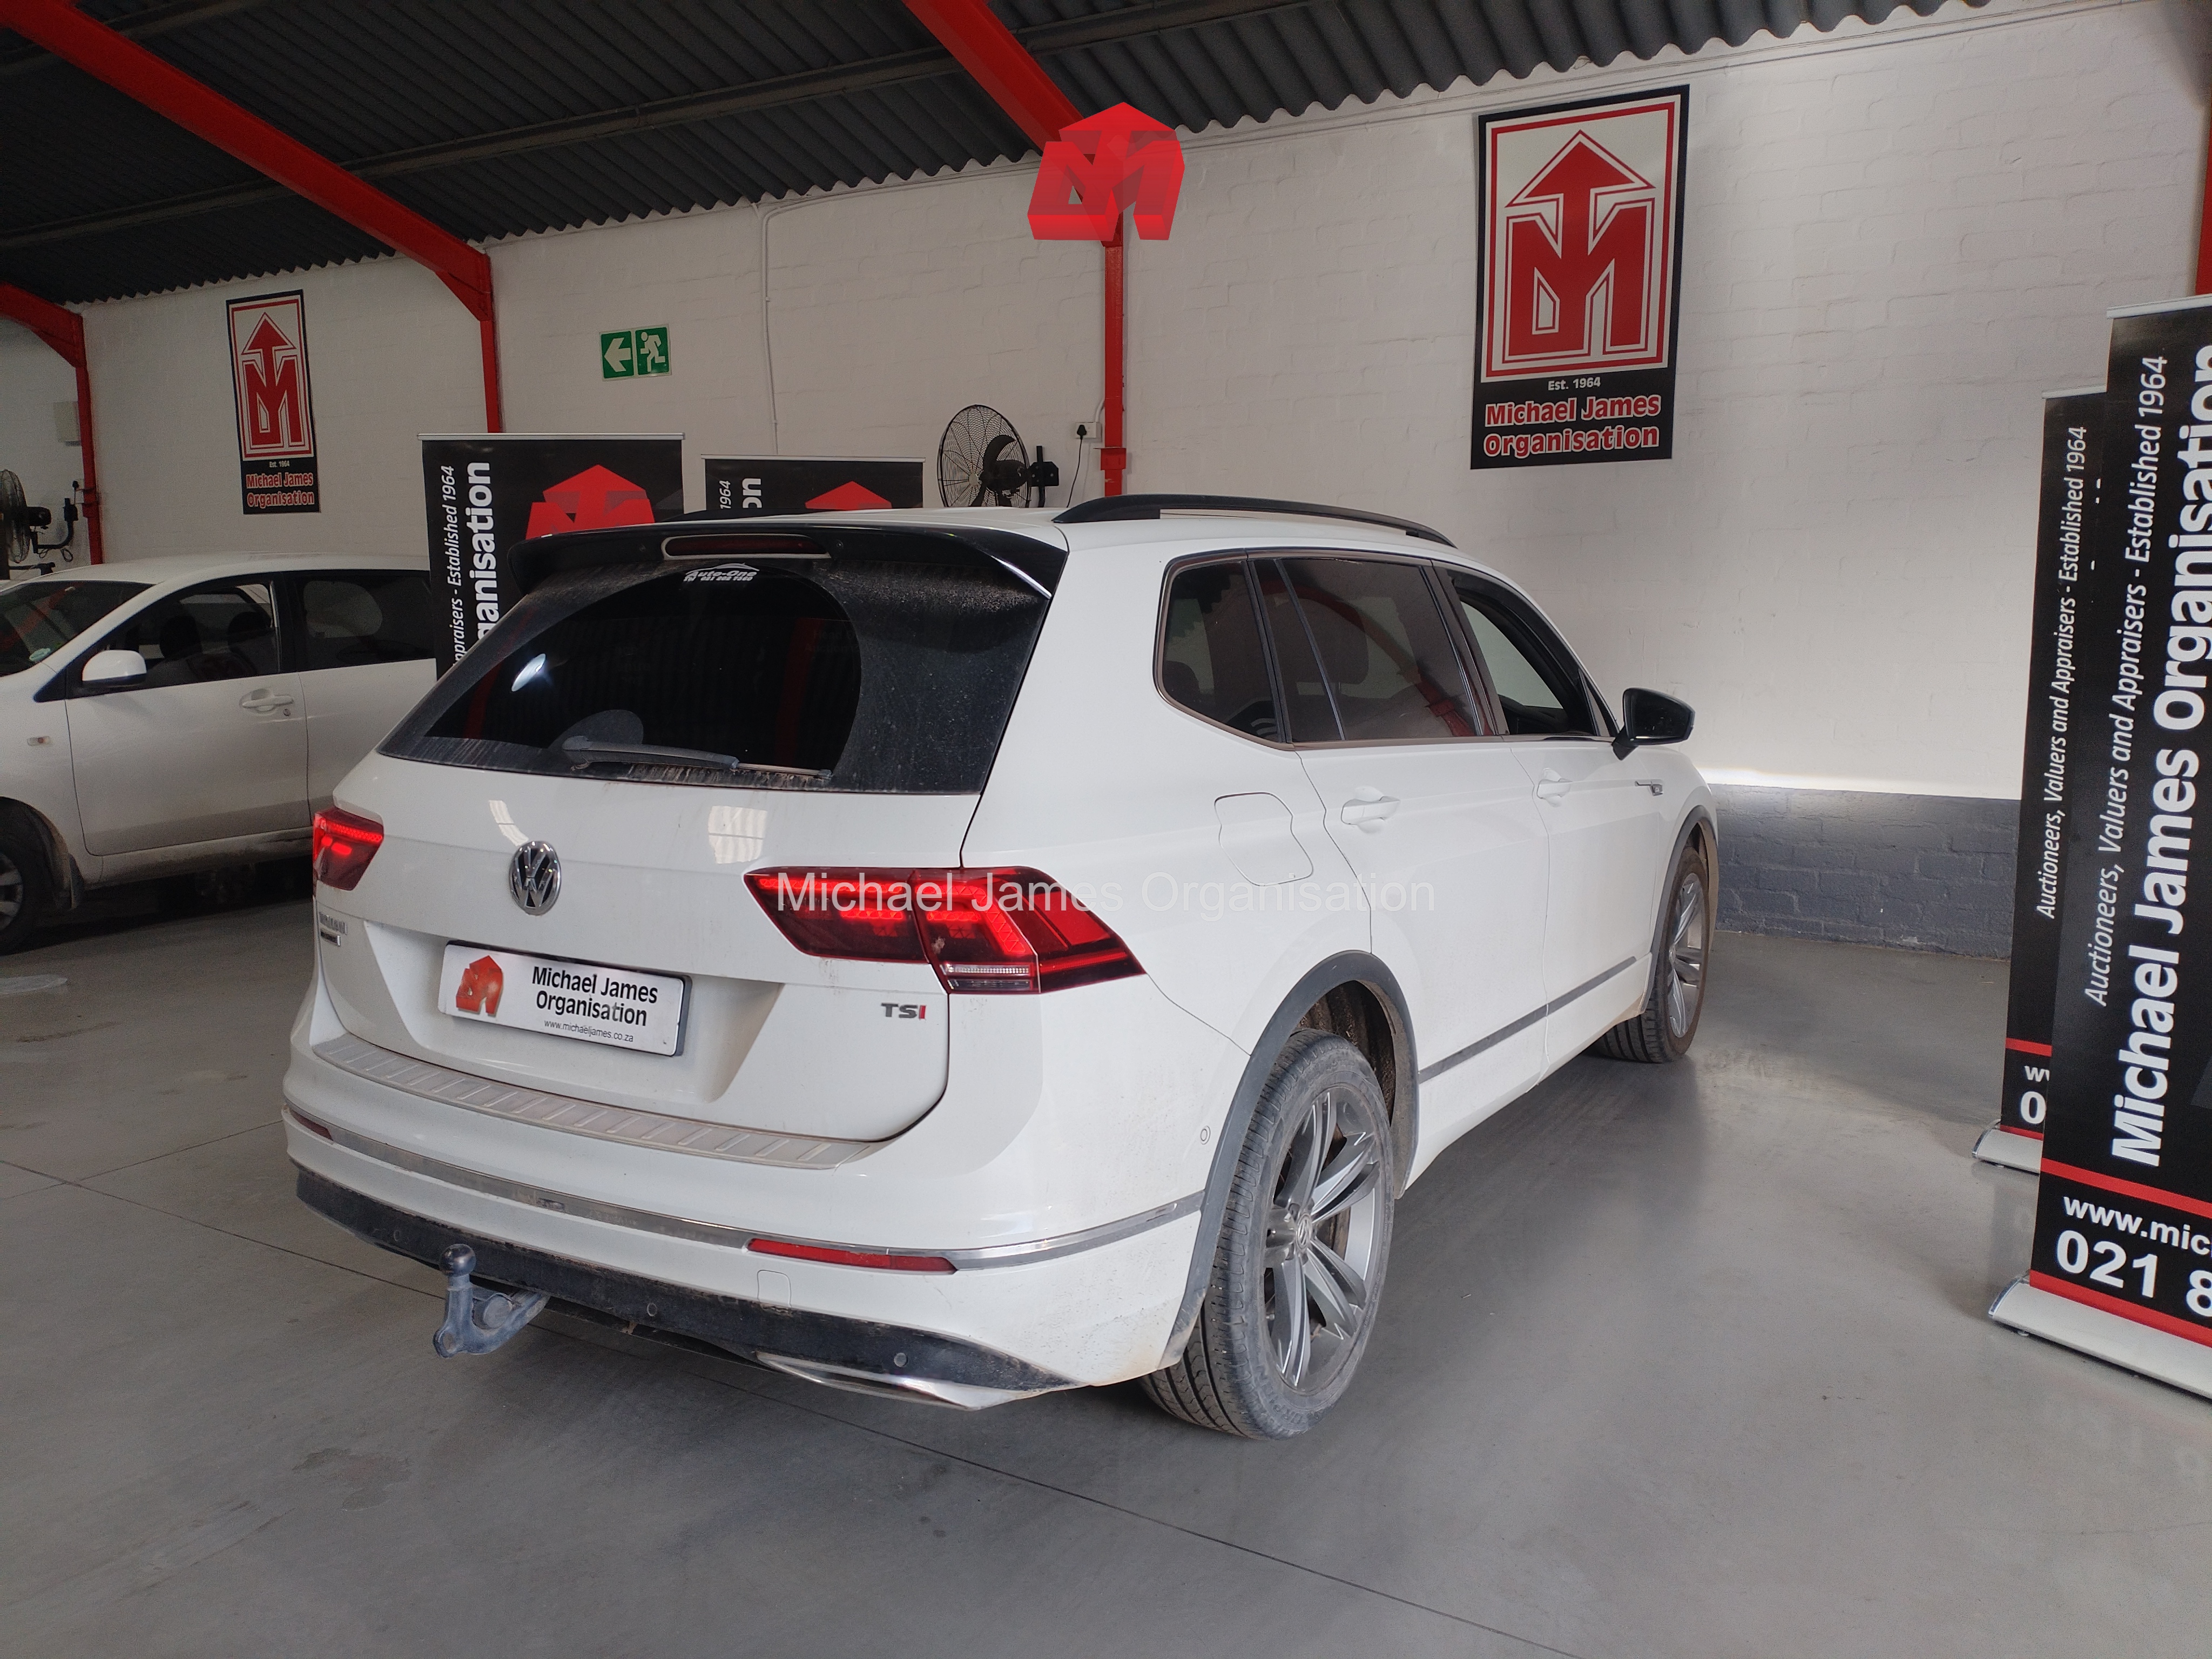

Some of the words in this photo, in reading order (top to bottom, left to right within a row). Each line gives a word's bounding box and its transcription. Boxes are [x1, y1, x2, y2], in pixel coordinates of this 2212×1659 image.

[1485, 397, 1576, 427] Michael
[1581, 394, 1661, 420] James
[1548, 379, 1569, 391] Est.
[1573, 376, 1601, 389] 1964
[2138, 356, 2168, 417] 1964
[1483, 424, 1660, 458] Organisation
[2065, 426, 2087, 473] 1964
[246, 473, 282, 489] Michael
[284, 471, 314, 487] James
[247, 490, 315, 509] Organisation
[440, 465, 455, 502] 1964
[2125, 424, 2162, 562] Established
[442, 504, 462, 587] Established
[2058, 476, 2084, 582] Established
[2052, 597, 2076, 694] Appraisers
[2112, 583, 2147, 711] Appraisers
[2049, 696, 2069, 732] and
[2109, 713, 2134, 761] and
[2044, 736, 2067, 801] Valuers
[2099, 767, 2129, 853] Valuers
[2036, 810, 2066, 919] Auctioneers,
[2134, 748, 2200, 935] James
[2084, 864, 2125, 1007] Auctioneers,
[532, 966, 598, 994] Michael
[601, 977, 658, 1004] James
[536, 990, 648, 1027] Organisation
[880, 1002, 926, 1019] TSI
[544, 1020, 633, 1043] www.michaeljames.co.za
[2111, 945, 2180, 1167] Michael
[2063, 1196, 2212, 1258] www.mic
[2056, 1229, 2158, 1298] 021
